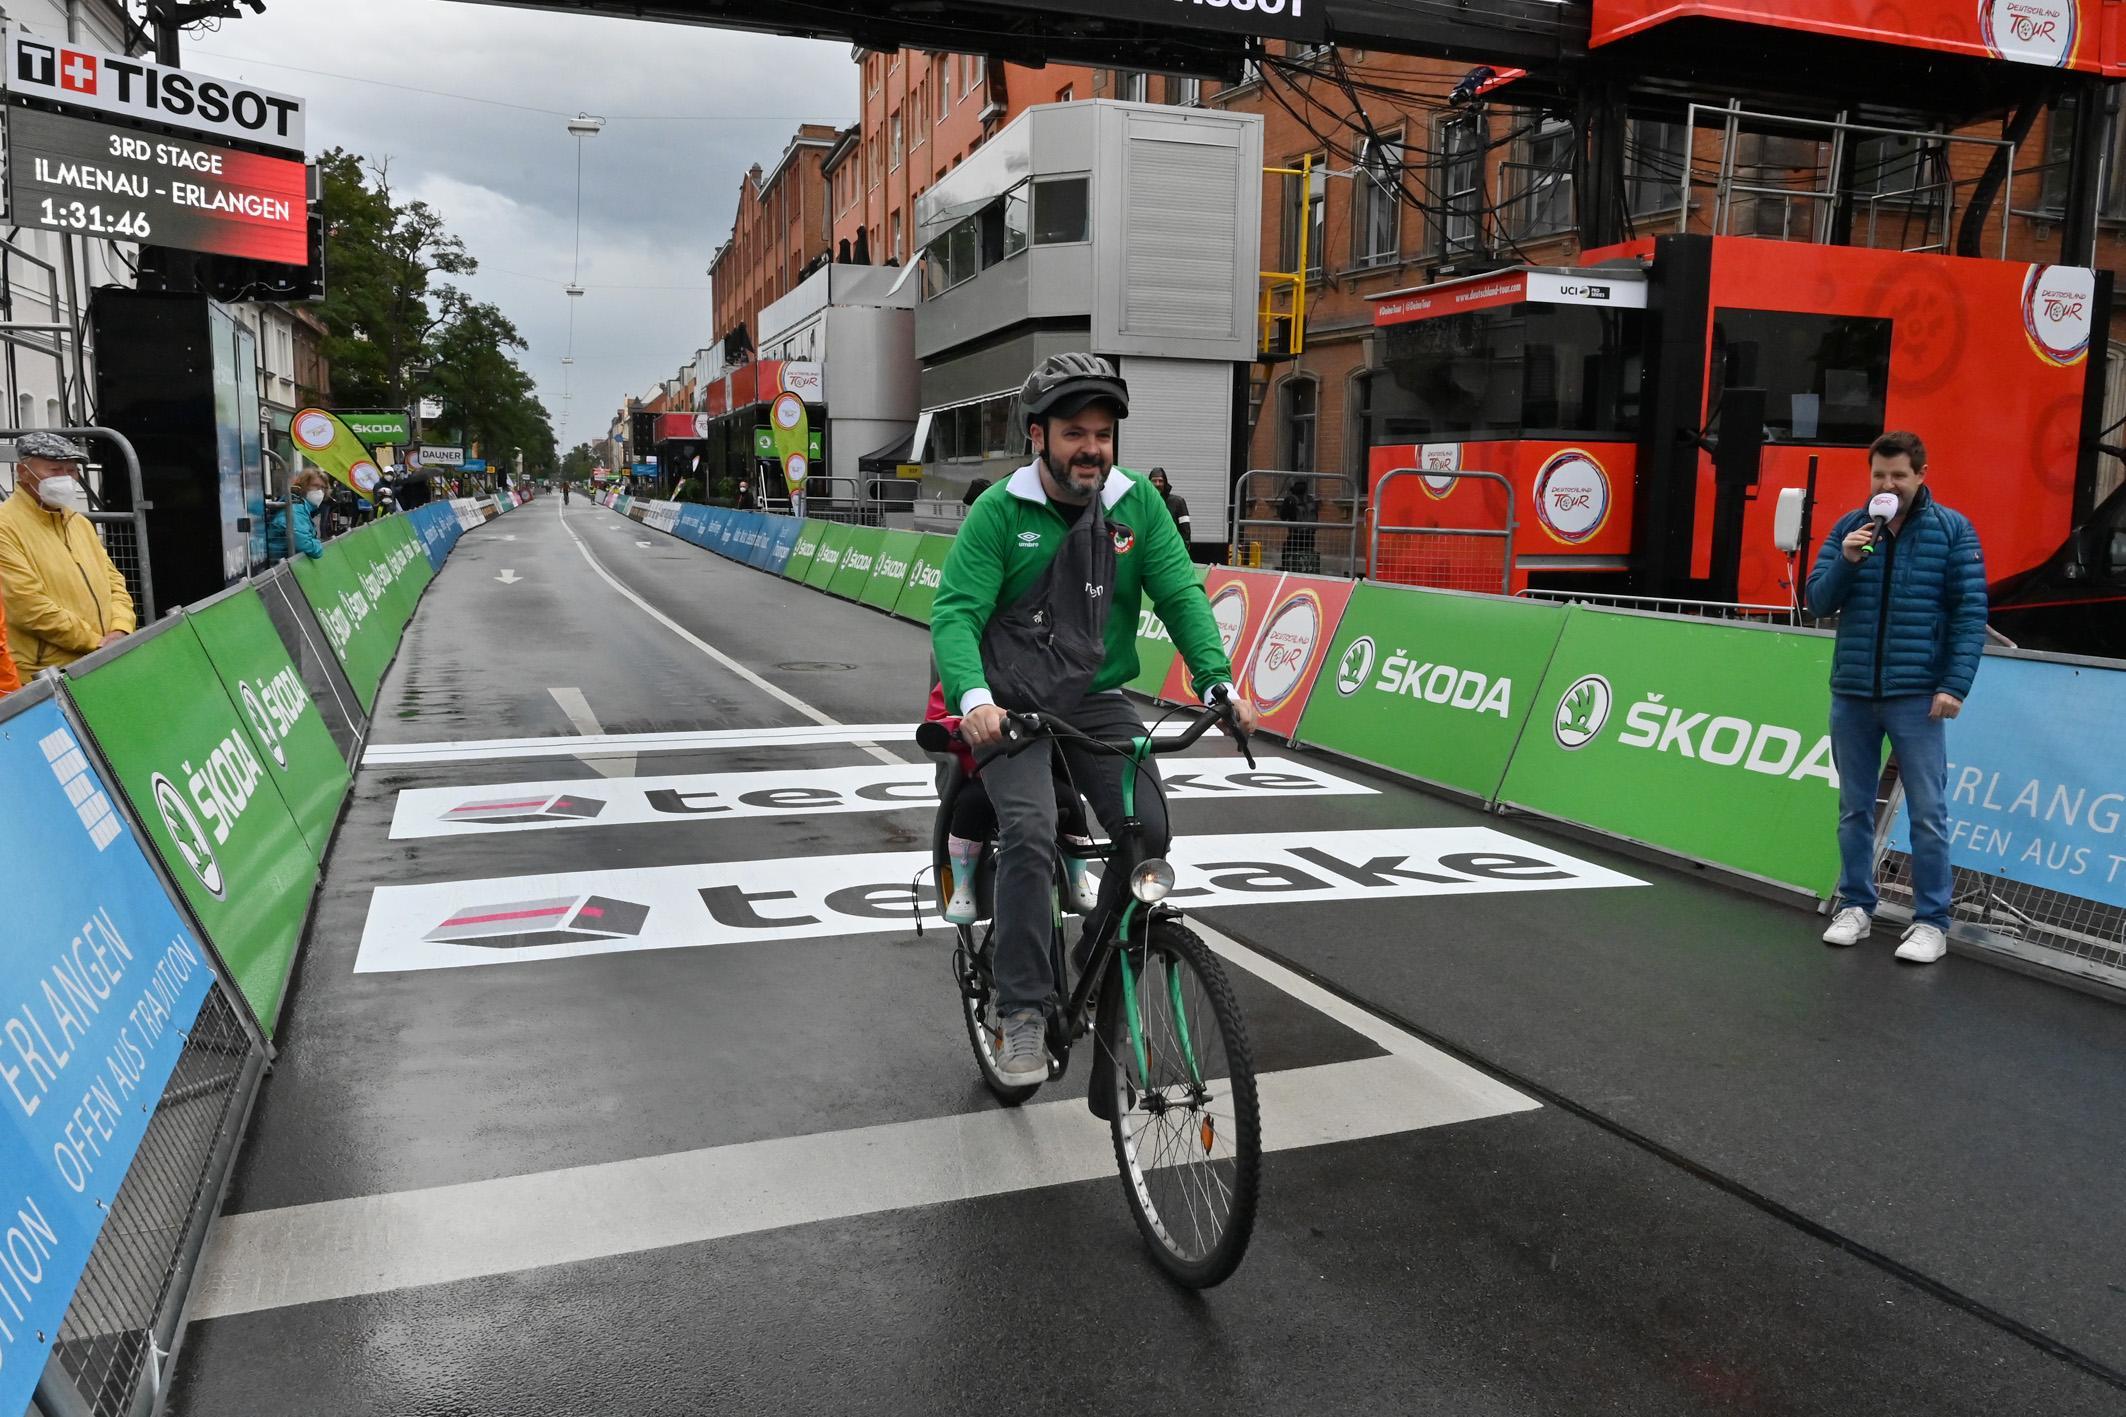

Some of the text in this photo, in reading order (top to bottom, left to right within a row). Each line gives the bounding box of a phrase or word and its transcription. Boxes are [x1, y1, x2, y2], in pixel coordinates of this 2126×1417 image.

[104, 59, 299, 137] TISSOT
[35, 158, 149, 198] ILMENAU
[172, 182, 289, 222] ERLANGEN
[109, 135, 223, 175] 3RD STAGE
[40, 198, 151, 237] 1:31:46
[1560, 286, 1578, 295] UCI
[256, 665, 310, 737] ŠKODA
[1375, 649, 1512, 718] ŠKODA
[1617, 692, 1840, 789] ŠKODA
[182, 728, 264, 846] ŠKODA
[2020, 838, 2092, 875] AUS
[0, 906, 134, 1117] ERLANGEN
[54, 934, 198, 1193] OFFEN AUS TRADITION
